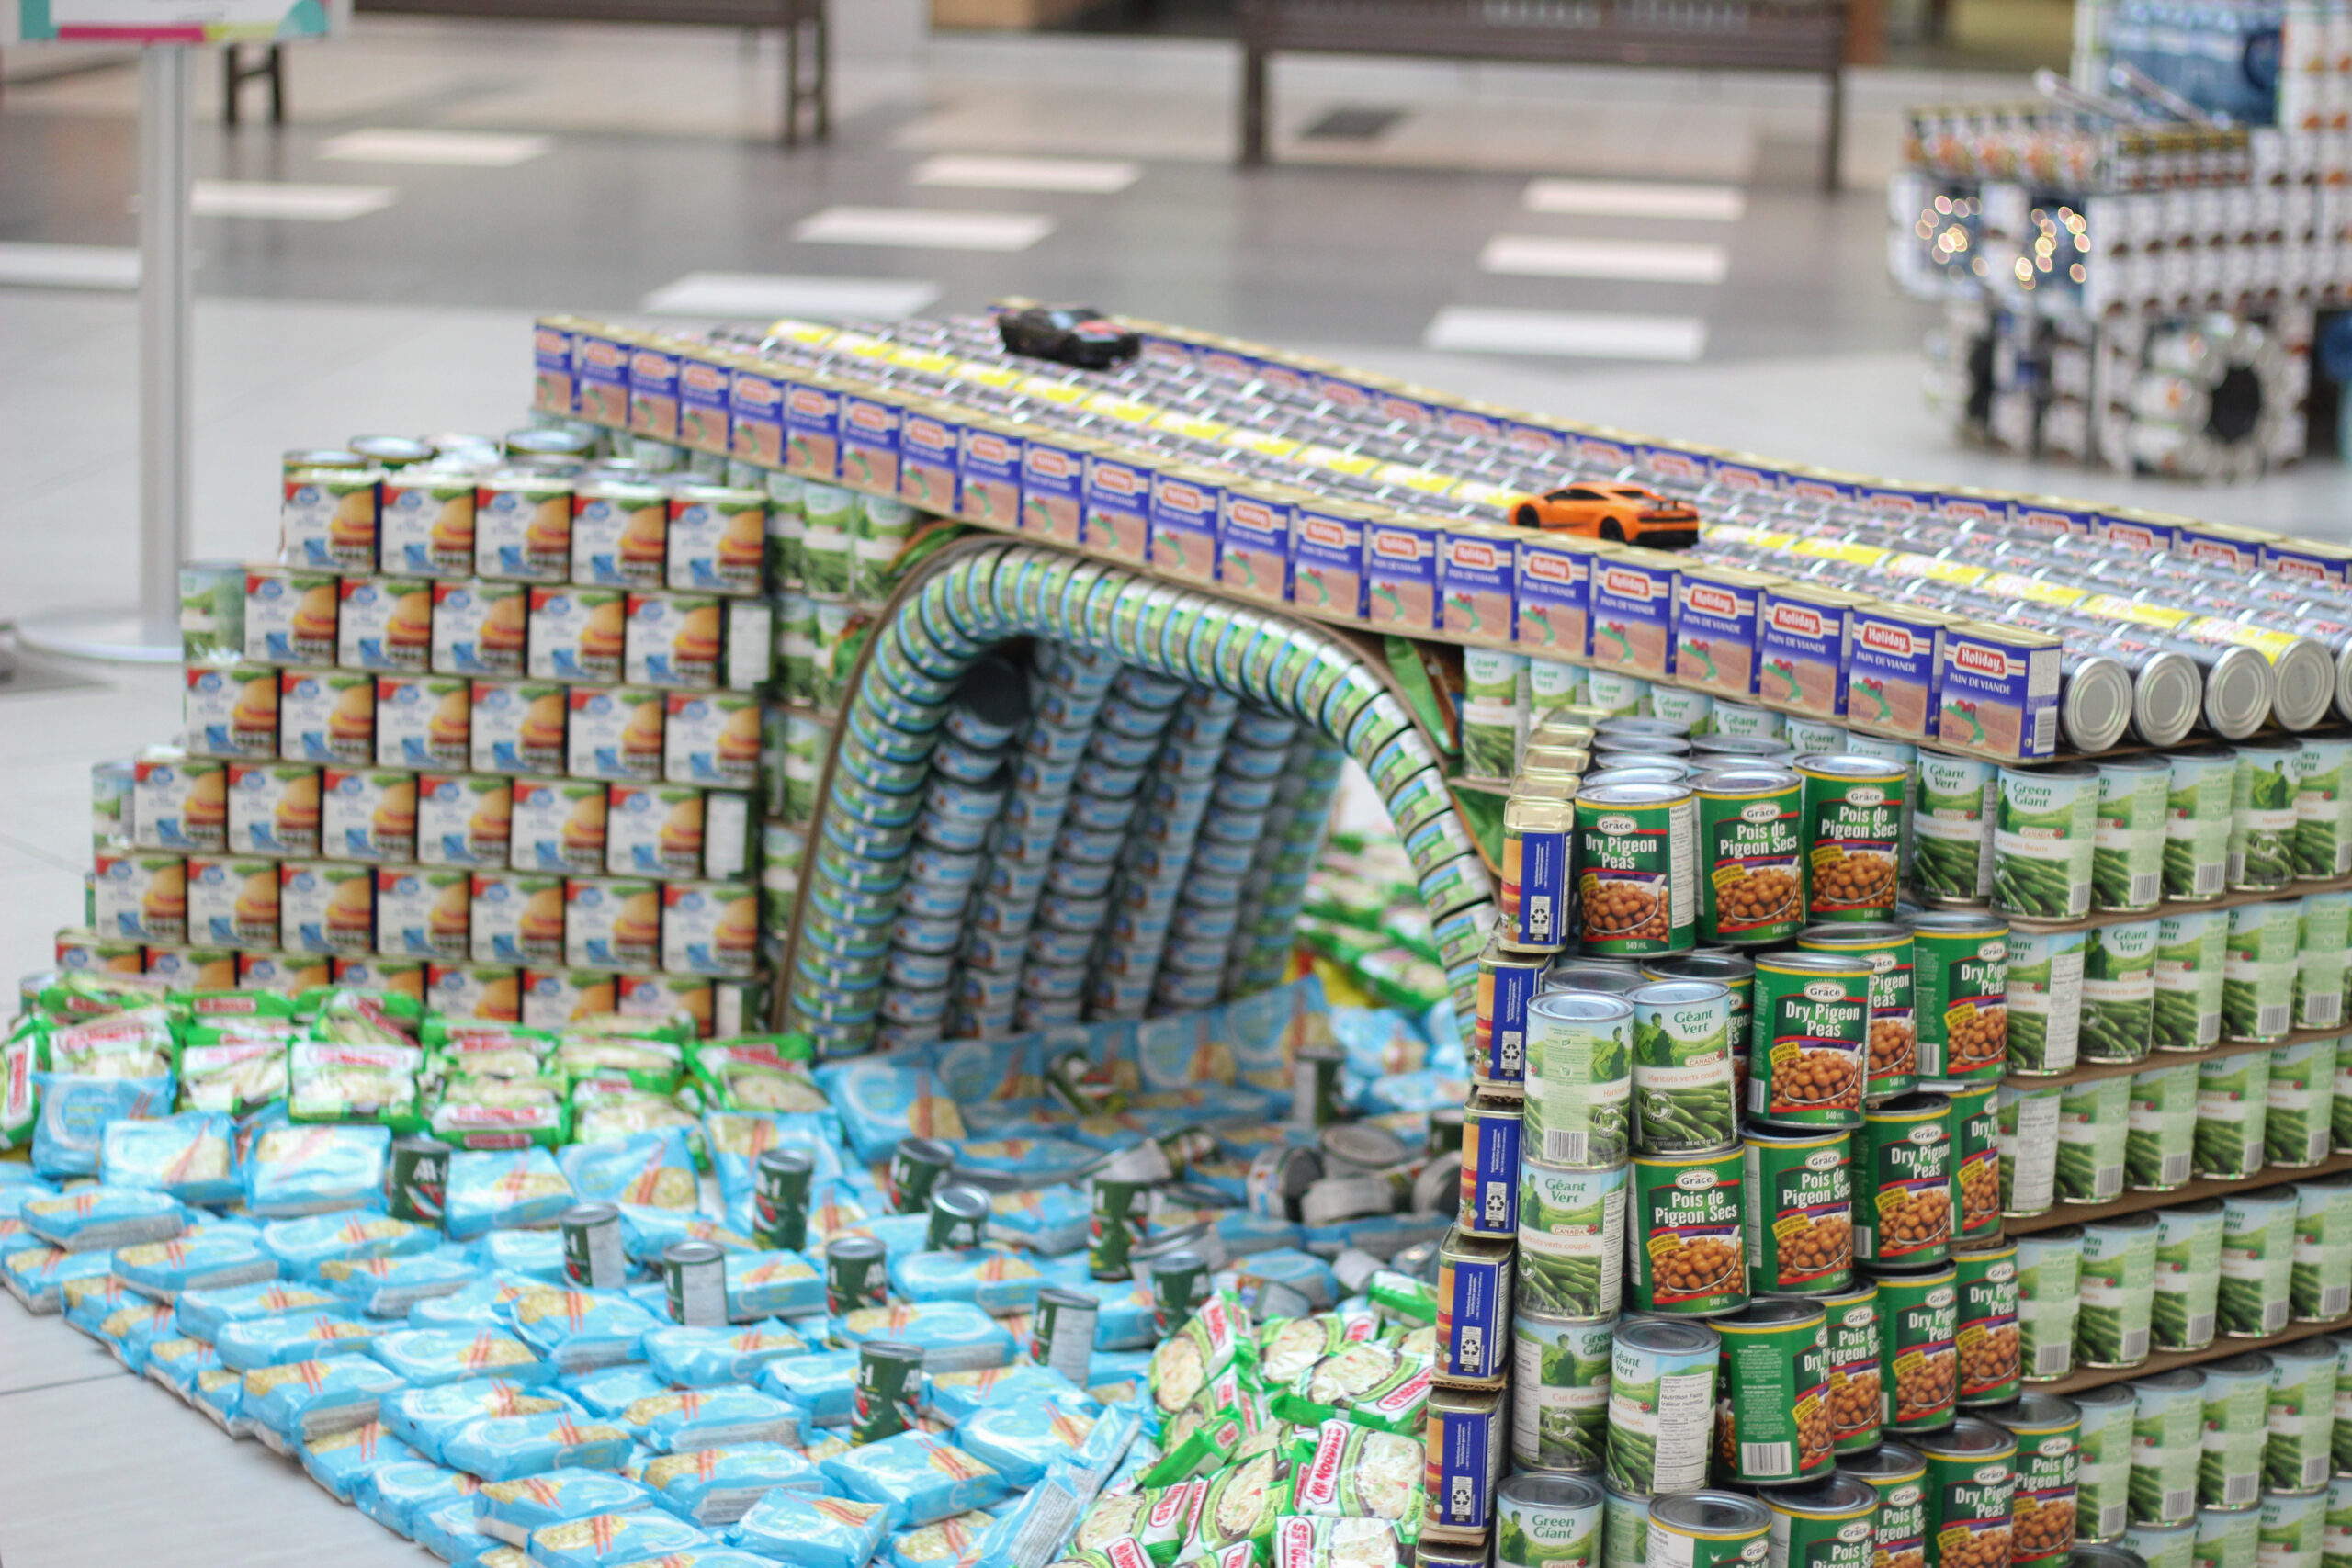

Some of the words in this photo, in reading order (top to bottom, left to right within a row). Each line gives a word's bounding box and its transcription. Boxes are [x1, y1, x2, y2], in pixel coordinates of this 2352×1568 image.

[1610, 573, 1647, 595] Holiday
[1694, 590, 1733, 613] Holiday
[1683, 614, 1700, 625] PAIN
[1702, 618, 1712, 627] DE
[1713, 621, 1741, 634] VIANDE
[1778, 609, 1818, 633] Holiday
[1767, 633, 1785, 645] PAIN
[1786, 637, 1796, 648] DE
[1797, 639, 1826, 654] VIANDE
[1868, 627, 1908, 652] Holiday
[1856, 651, 1874, 664] PAIN
[1875, 656, 1885, 666] DE
[1886, 659, 1917, 673] VIANDE
[1962, 648, 2002, 672] Holiday
[1950, 672, 1967, 685] PAIN
[1969, 678, 1979, 689] DE
[1981, 681, 2011, 695] VIANDE
[1724, 712, 1758, 728] Géant
[1800, 728, 1835, 744] Géant
[1930, 763, 1965, 780] Géant
[1934, 776, 1959, 789] Vert
[2013, 781, 2052, 796] Green
[1850, 792, 1880, 801] Grace
[2014, 795, 2049, 807] Giant
[1747, 807, 1776, 818] Grace
[1839, 806, 1869, 823] Pois
[1873, 807, 1888, 822] de
[1601, 820, 1631, 830] Grace
[1736, 823, 1767, 840] Pois
[1771, 821, 1786, 837] de
[1821, 819, 1869, 840] Pigeon
[1873, 822, 1898, 838] Secs
[1585, 833, 1603, 856] Dry
[1608, 836, 1657, 856] Pigeon
[1720, 839, 1769, 860] Pigeon
[1772, 835, 1797, 853] Secs
[1601, 852, 1635, 870] Peas
[2113, 928, 2148, 942] Géant
[1983, 947, 2003, 956] Grace
[2120, 940, 2143, 952] Vert
[1961, 964, 1984, 984] Dry
[1810, 987, 1840, 998] Grace
[1981, 980, 2004, 996] Peas
[1874, 994, 1896, 1008] eas
[1673, 1010, 1713, 1025] Géant
[1785, 1000, 1810, 1020] Dry
[1815, 1004, 1860, 1023] Pigeon
[1681, 1022, 1708, 1036] Vert
[1807, 1020, 1841, 1037] Peas
[1690, 1056, 1716, 1065] CANADA
[1680, 1074, 1700, 1082] verts
[1826, 1110, 1836, 1120] 540
[1914, 1131, 1939, 1141] Grace
[1971, 1120, 1989, 1138] Dry
[1811, 1154, 1838, 1166] Grace
[1891, 1147, 1916, 1168] Dry
[1913, 1161, 1941, 1179] Peas
[1544, 1178, 1587, 1192] Géant
[1681, 1176, 1713, 1186] Grace
[1801, 1172, 1830, 1190] Pois
[1833, 1168, 1845, 1184] de
[1551, 1191, 1578, 1203] Vert
[1671, 1190, 1703, 1209] Pois
[1707, 1190, 1724, 1206] de
[1782, 1187, 1831, 1209] Pigeon
[1834, 1181, 1851, 1200] Secs
[1655, 1206, 1705, 1228] Pigeon
[1709, 1204, 1736, 1223] Secs
[1544, 1240, 1562, 1249] verts
[1564, 1241, 1591, 1251] coupés
[1991, 1268, 2014, 1278] Grace
[1709, 1297, 1719, 1307] 540
[1930, 1292, 1952, 1303] Grace
[1970, 1285, 1993, 1306] Dry
[1990, 1299, 2014, 1317] Peas
[1848, 1311, 1870, 1323] Grace
[1908, 1311, 1932, 1332] Dry
[1839, 1330, 1865, 1347] Pois
[1929, 1323, 1952, 1342] Peas
[1613, 1348, 1641, 1368] Géant
[1804, 1354, 1822, 1372] Dry
[1615, 1360, 1634, 1378] Vert
[1552, 1393, 1567, 1402] Cut
[1319, 1427, 1342, 1478] NOODLES
[2043, 1440, 2068, 1453] Grace
[2032, 1457, 2061, 1473] Pois
[2064, 1454, 2074, 1470] de
[1979, 1472, 2005, 1482] Grace
[2014, 1472, 2060, 1493] Pigeon
[1893, 1490, 1917, 1503] Grace
[1955, 1486, 1980, 1507] Dry
[1883, 1509, 1910, 1526] Pois
[1912, 1503, 1922, 1520] de
[1976, 1503, 2005, 1519] Peas
[1532, 1514, 1575, 1528] Green
[1533, 1525, 1572, 1539] Giant
[1843, 1526, 1867, 1538] Grace
[1875, 1522, 1910, 1544] igeon
[1746, 1545, 1768, 1557] Grace
[1832, 1543, 1859, 1562] Pois
[1861, 1540, 1872, 1555] de
